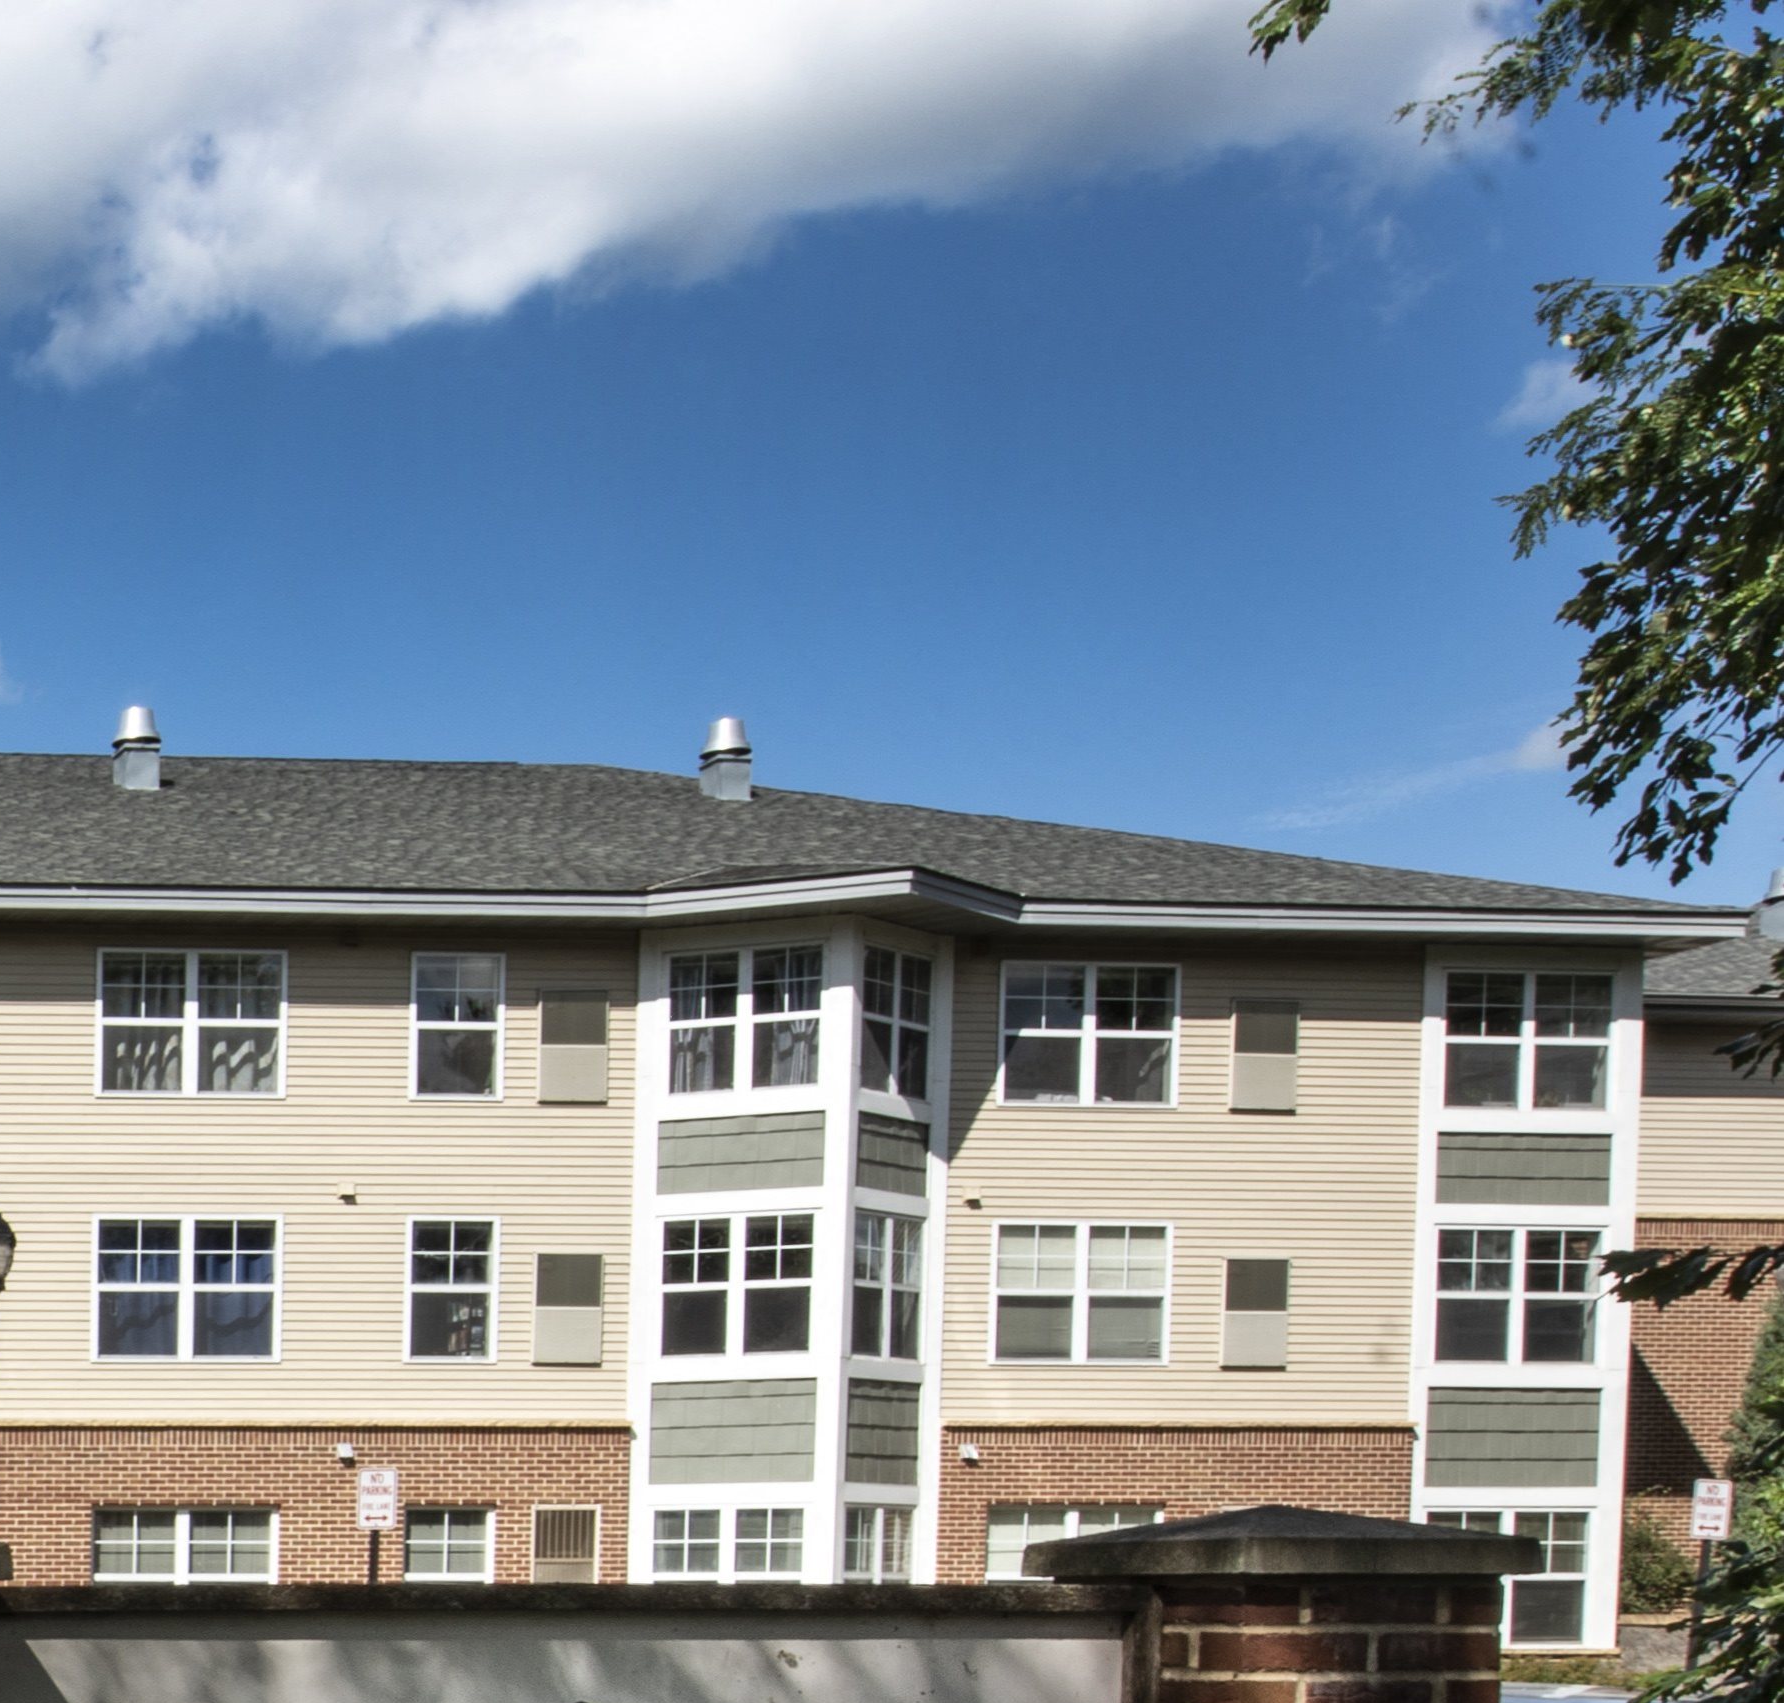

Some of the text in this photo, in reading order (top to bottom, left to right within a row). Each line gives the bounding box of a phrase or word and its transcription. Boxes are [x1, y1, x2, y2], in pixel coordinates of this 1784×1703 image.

[369, 1473, 385, 1484] NO
[362, 1485, 392, 1496] PARKING
[1706, 1485, 1720, 1496] NO
[1698, 1496, 1725, 1506] PARKING
